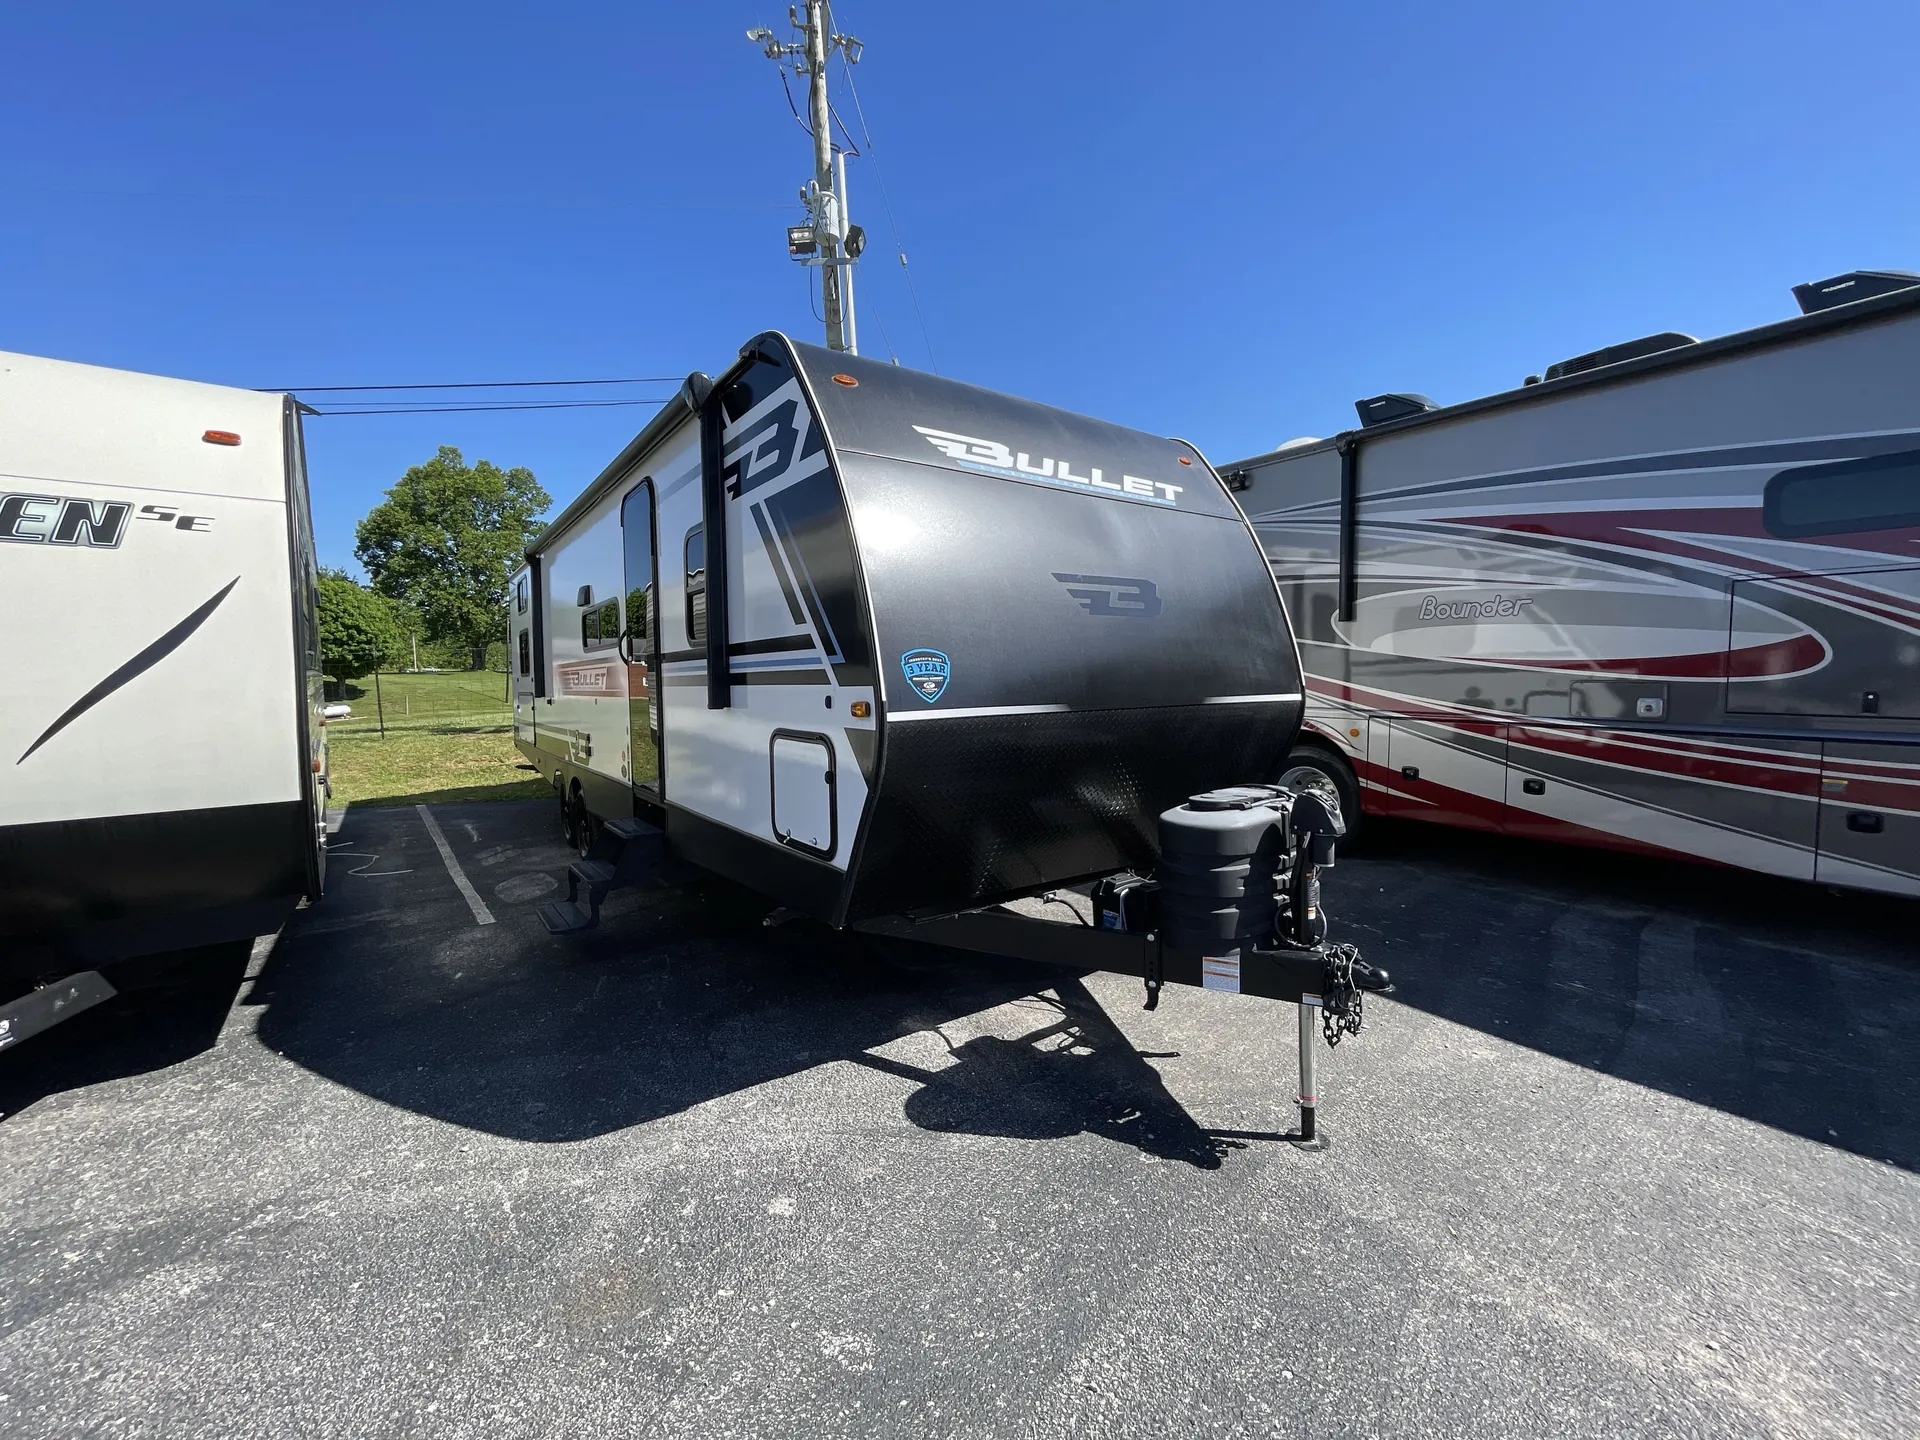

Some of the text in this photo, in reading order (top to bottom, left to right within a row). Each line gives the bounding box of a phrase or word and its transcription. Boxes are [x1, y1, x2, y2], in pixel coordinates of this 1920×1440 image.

[1418, 594, 1534, 621] Bounder
[907, 662, 946, 675] 3 YEAR
[564, 671, 606, 686] BULLET
